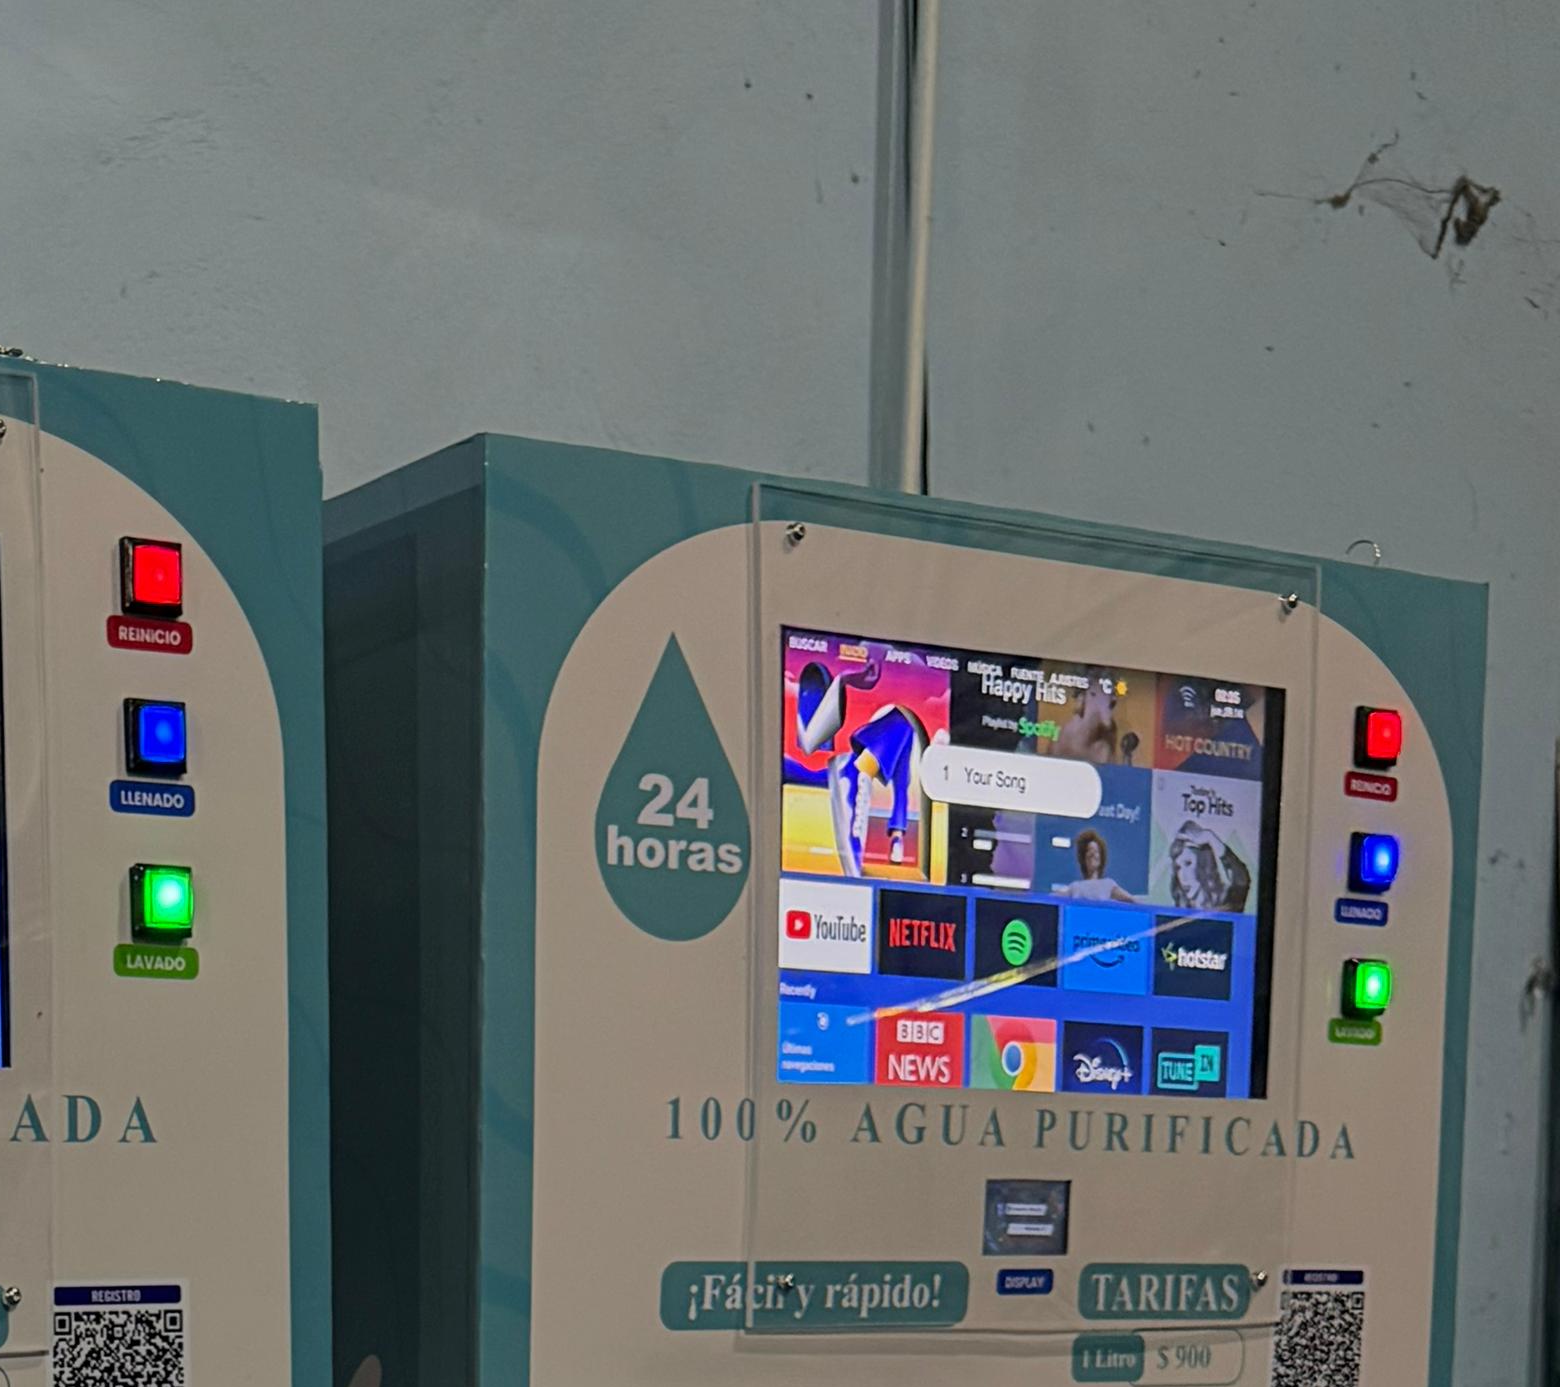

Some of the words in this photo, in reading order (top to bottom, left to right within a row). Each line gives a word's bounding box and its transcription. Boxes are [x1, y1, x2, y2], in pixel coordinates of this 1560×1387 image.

[119, 625, 181, 646] REINICIO
[981, 672, 1032, 704] Happy
[1036, 680, 1067, 705] Hits
[963, 767, 993, 786] Your
[995, 772, 1027, 793] Song
[121, 790, 185, 809] LLENADO
[637, 773, 714, 829] 24
[1181, 793, 1206, 817] Top
[1208, 797, 1234, 817] Hits
[606, 824, 743, 874] horas
[814, 915, 866, 942] YouTube
[889, 918, 956, 952] NETFLIX
[126, 953, 186, 971] LAVADO
[1177, 947, 1228, 971] hotstar
[888, 1053, 951, 1083] NEWS
[665, 1096, 817, 1143] 100%
[850, 1101, 1006, 1148] AGUA
[1035, 1108, 1355, 1160] PURIFICADA
[91, 1289, 142, 1303] REGISTRO
[793, 1284, 815, 1319] y
[825, 1274, 941, 1319] rápido!
[1092, 1273, 1239, 1313] TARIFAS
[1082, 1349, 1089, 1368] 1
[1093, 1347, 1136, 1368] Litro
[1157, 1346, 1170, 1370] $
[1175, 1344, 1212, 1369] 900
